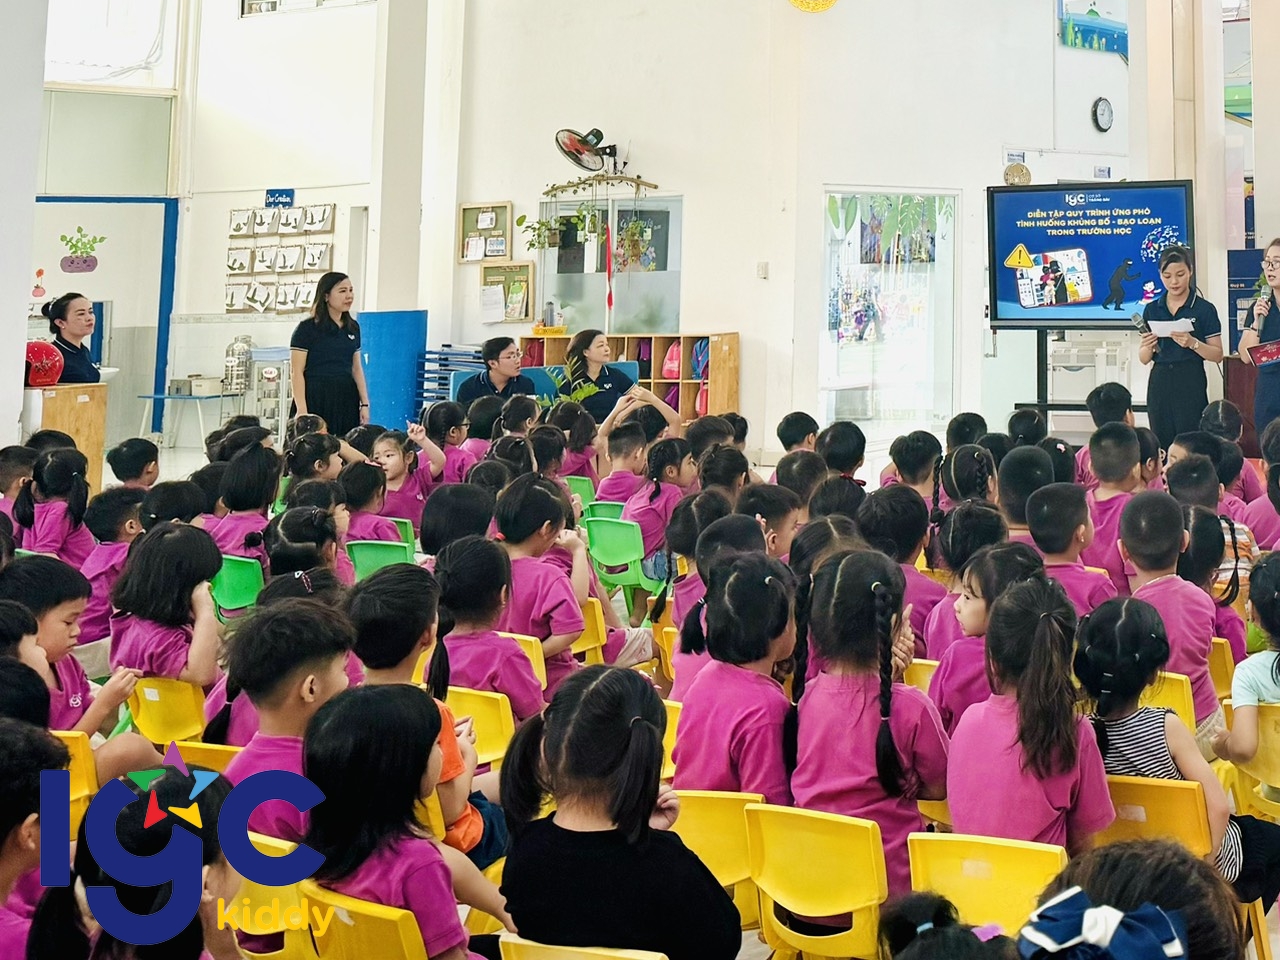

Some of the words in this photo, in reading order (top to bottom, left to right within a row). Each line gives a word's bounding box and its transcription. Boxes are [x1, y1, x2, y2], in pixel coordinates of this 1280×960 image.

[1048, 210, 1064, 218] TẬP
[1112, 208, 1131, 216] ỨNG
[1016, 219, 1034, 227] TÌNH
[1037, 217, 1066, 226] HUỐNG
[1098, 217, 1110, 226] BỐ
[1118, 218, 1136, 226] BẠO
[1078, 227, 1111, 235] TRƯỜNG
